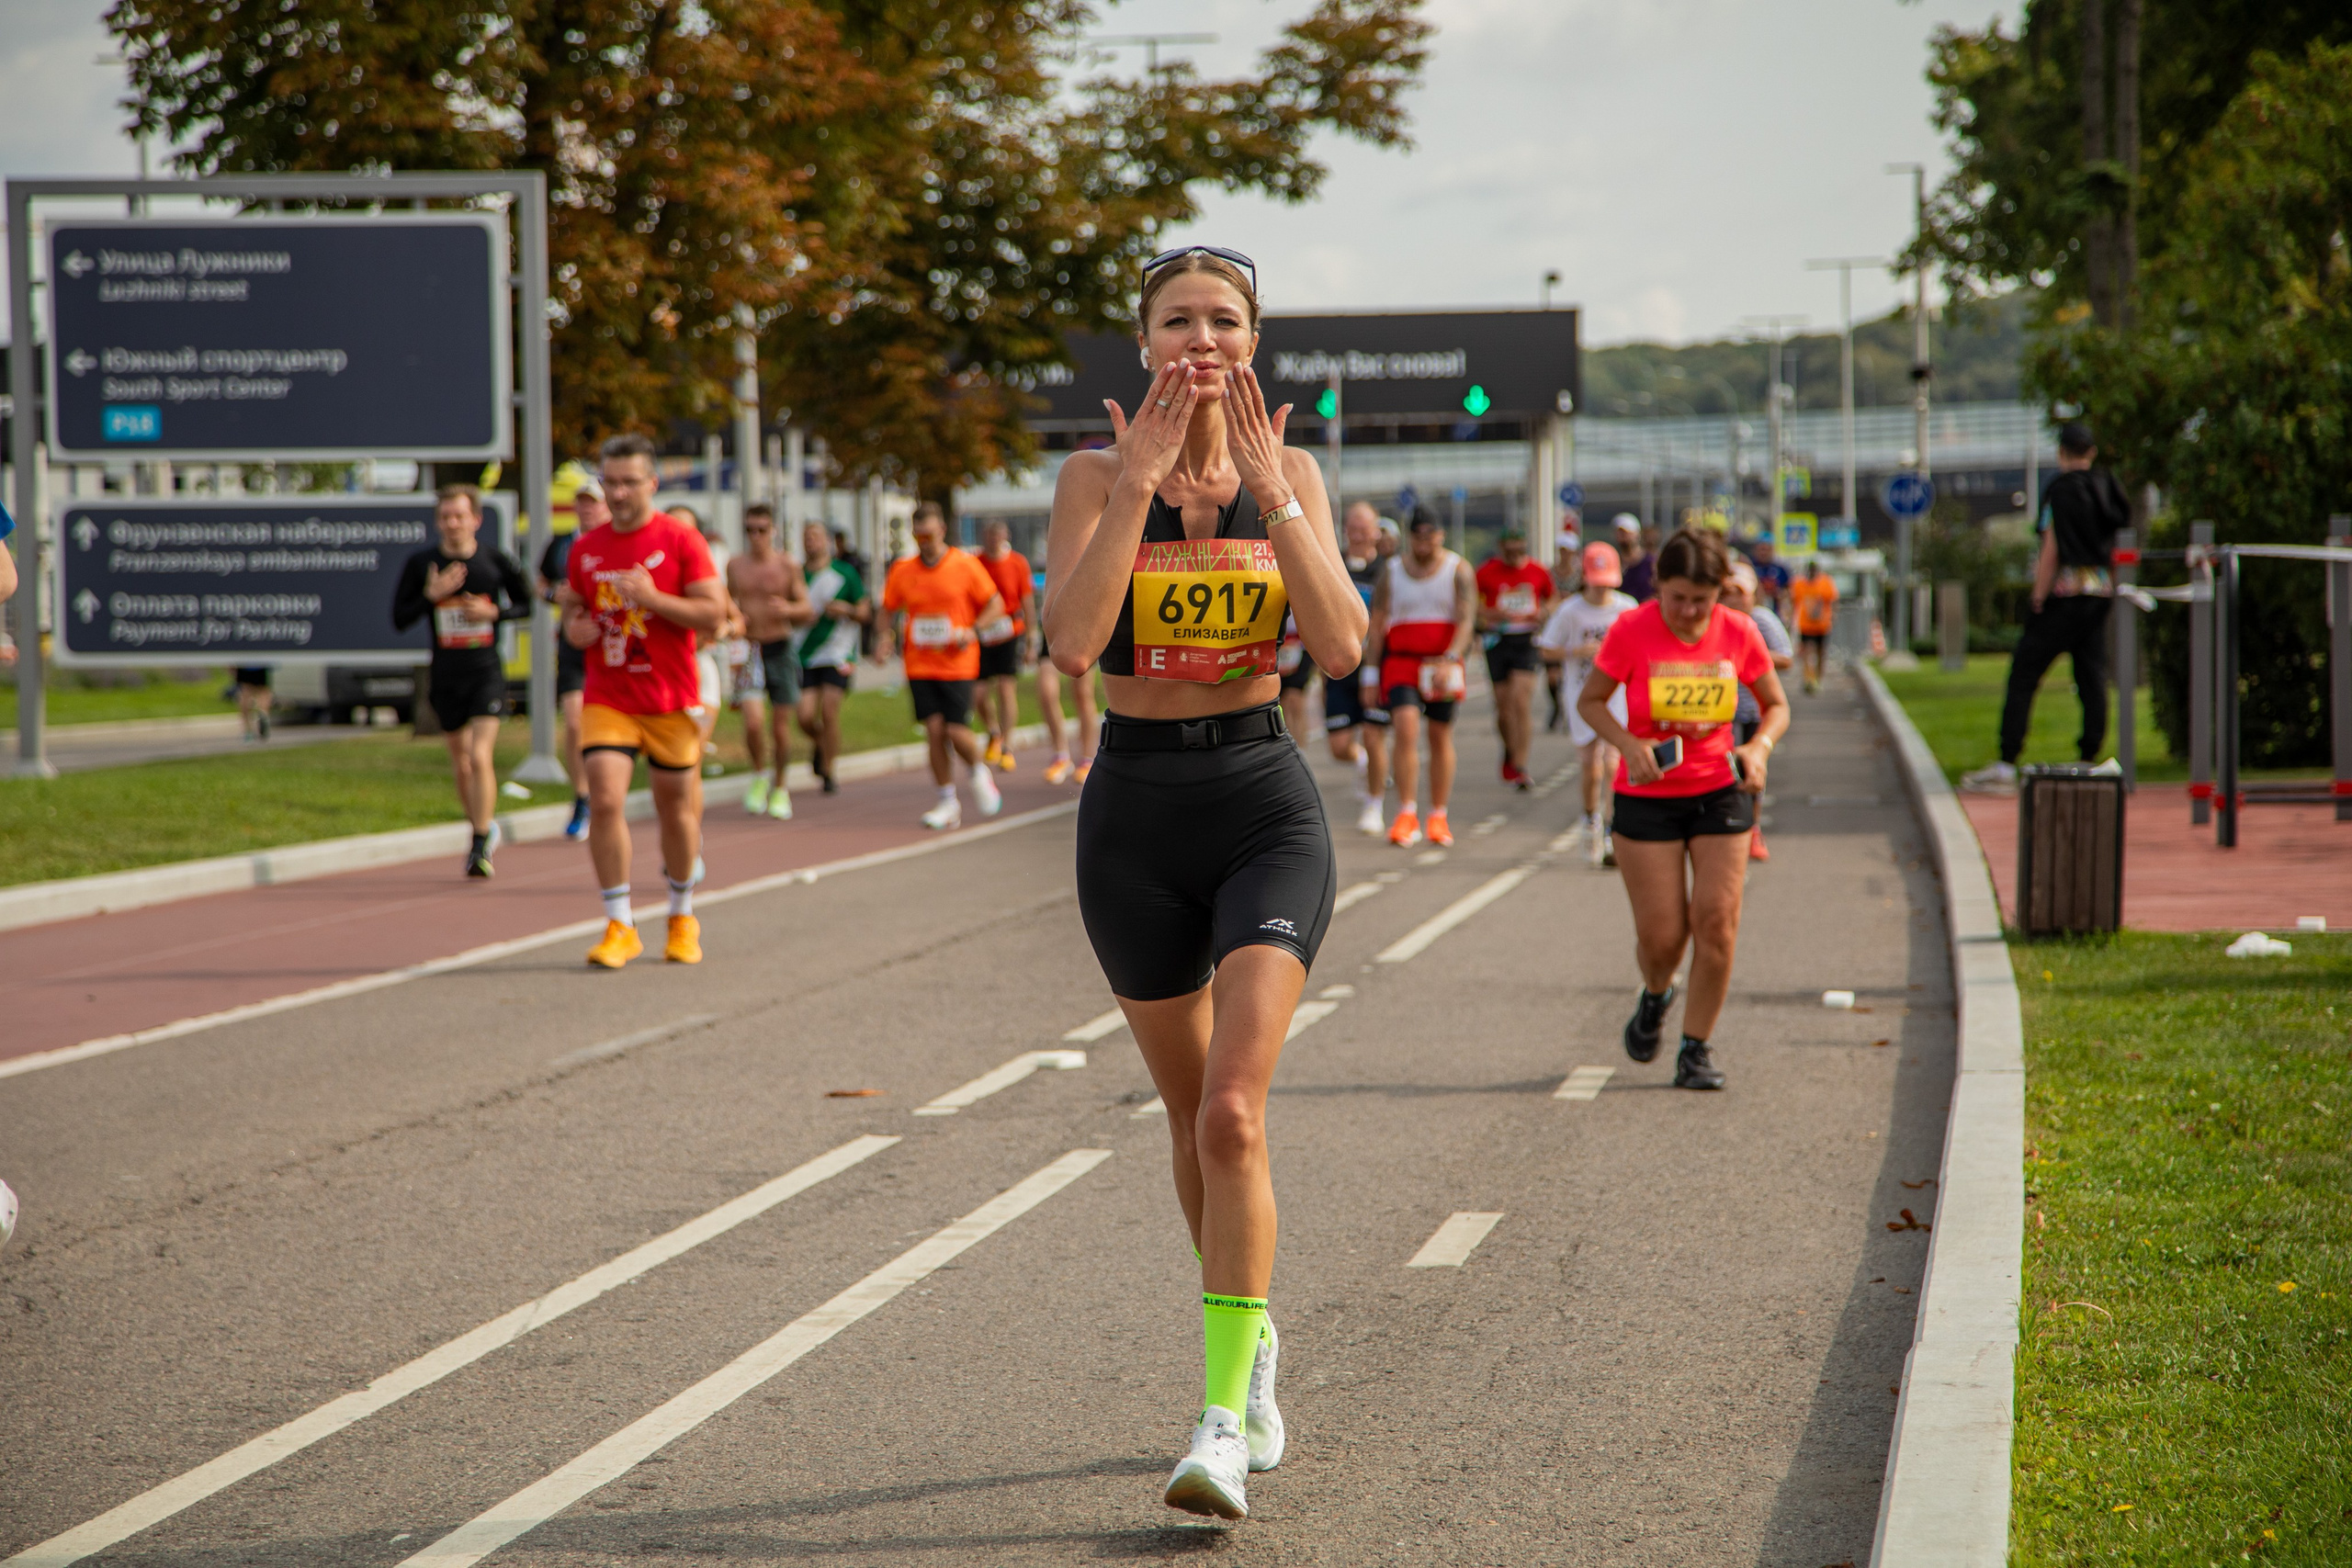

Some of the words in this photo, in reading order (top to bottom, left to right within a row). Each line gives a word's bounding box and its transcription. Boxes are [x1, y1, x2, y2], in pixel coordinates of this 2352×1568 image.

[97, 249, 175, 275] Улица
[176, 248, 291, 278] Лужники
[187, 279, 250, 301] street
[100, 346, 198, 373] Южный
[199, 349, 347, 376] спортцентр
[1344, 350, 1387, 379] Вас
[1387, 347, 1466, 379] снова!
[102, 377, 163, 400] South
[164, 377, 220, 404] Sport
[221, 377, 292, 400] Center
[107, 519, 272, 550] Фрунзенская
[274, 517, 425, 548] набережная
[108, 549, 245, 576] Frunzenskaya
[246, 548, 379, 571] embankment
[109, 592, 199, 617] Оплата
[200, 594, 321, 620] парковки
[1159, 582, 1268, 624] 6917
[109, 618, 199, 646] Payment
[198, 617, 231, 646] for
[232, 617, 312, 645] Parking
[1174, 627, 1250, 640] ЕЛИЗАВЕТА
[1151, 649, 1166, 670] E
[1665, 683, 1724, 705] 2227
[1259, 924, 1297, 936] ATHLEX
